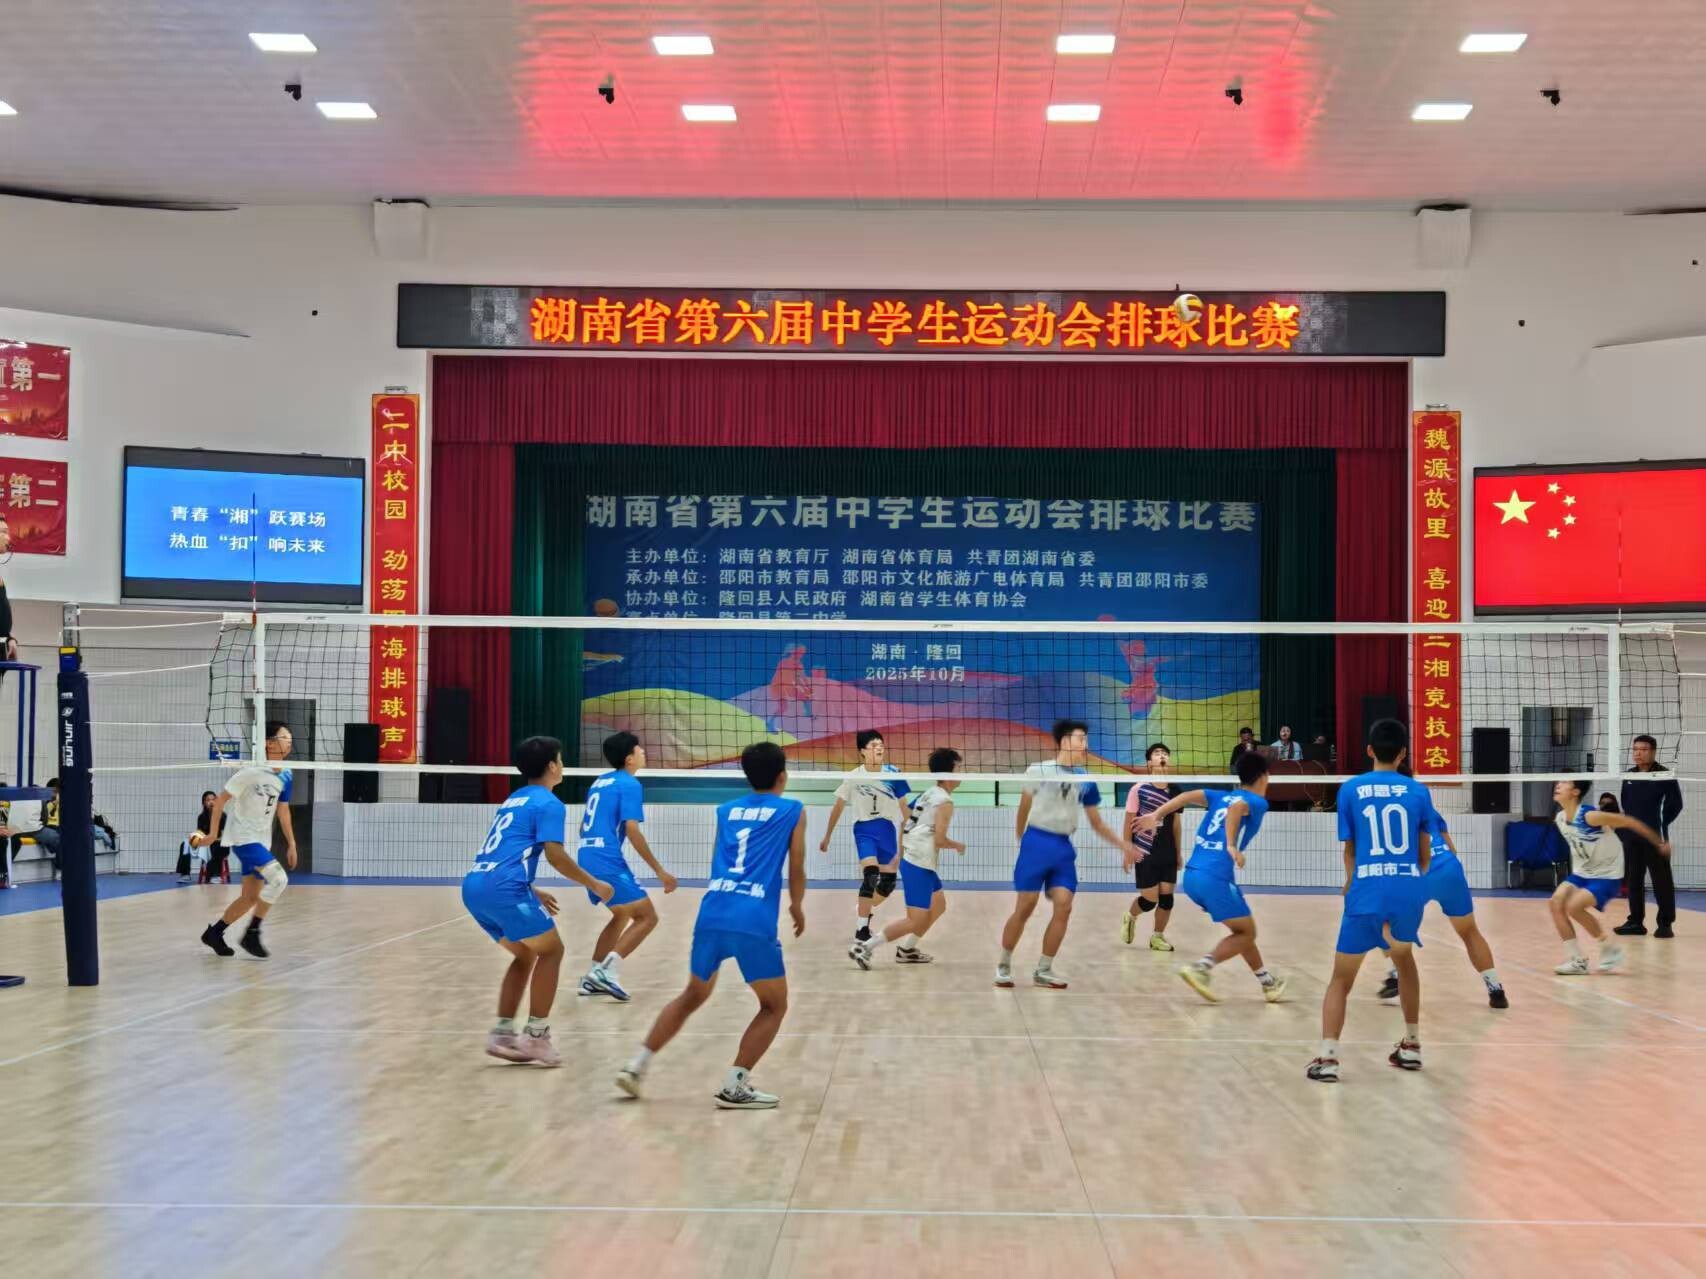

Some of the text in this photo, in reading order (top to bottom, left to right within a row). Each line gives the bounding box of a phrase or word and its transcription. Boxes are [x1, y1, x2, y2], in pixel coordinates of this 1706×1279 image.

[530, 296, 1300, 350] 湖南省第六届中学生运动会排球比赛
[0, 472, 59, 508] 第二
[1423, 428, 1452, 540] 魏源故里
[585, 494, 1257, 531] 湖南省第六届中学生运动会排球比赛
[842, 548, 953, 566] 湖南省体育局
[967, 549, 1096, 567] 共青团湖南省委
[842, 569, 1065, 588] 邵阳市文化旅游广电体育局
[1079, 571, 1209, 589] 共青团邵阳市委
[860, 590, 1027, 607] 湖南省学生体育协会
[865, 665, 965, 682] 2025年10月
[583, 792, 600, 832] 9
[1361, 803, 1410, 856] 10
[728, 827, 752, 874] 1
